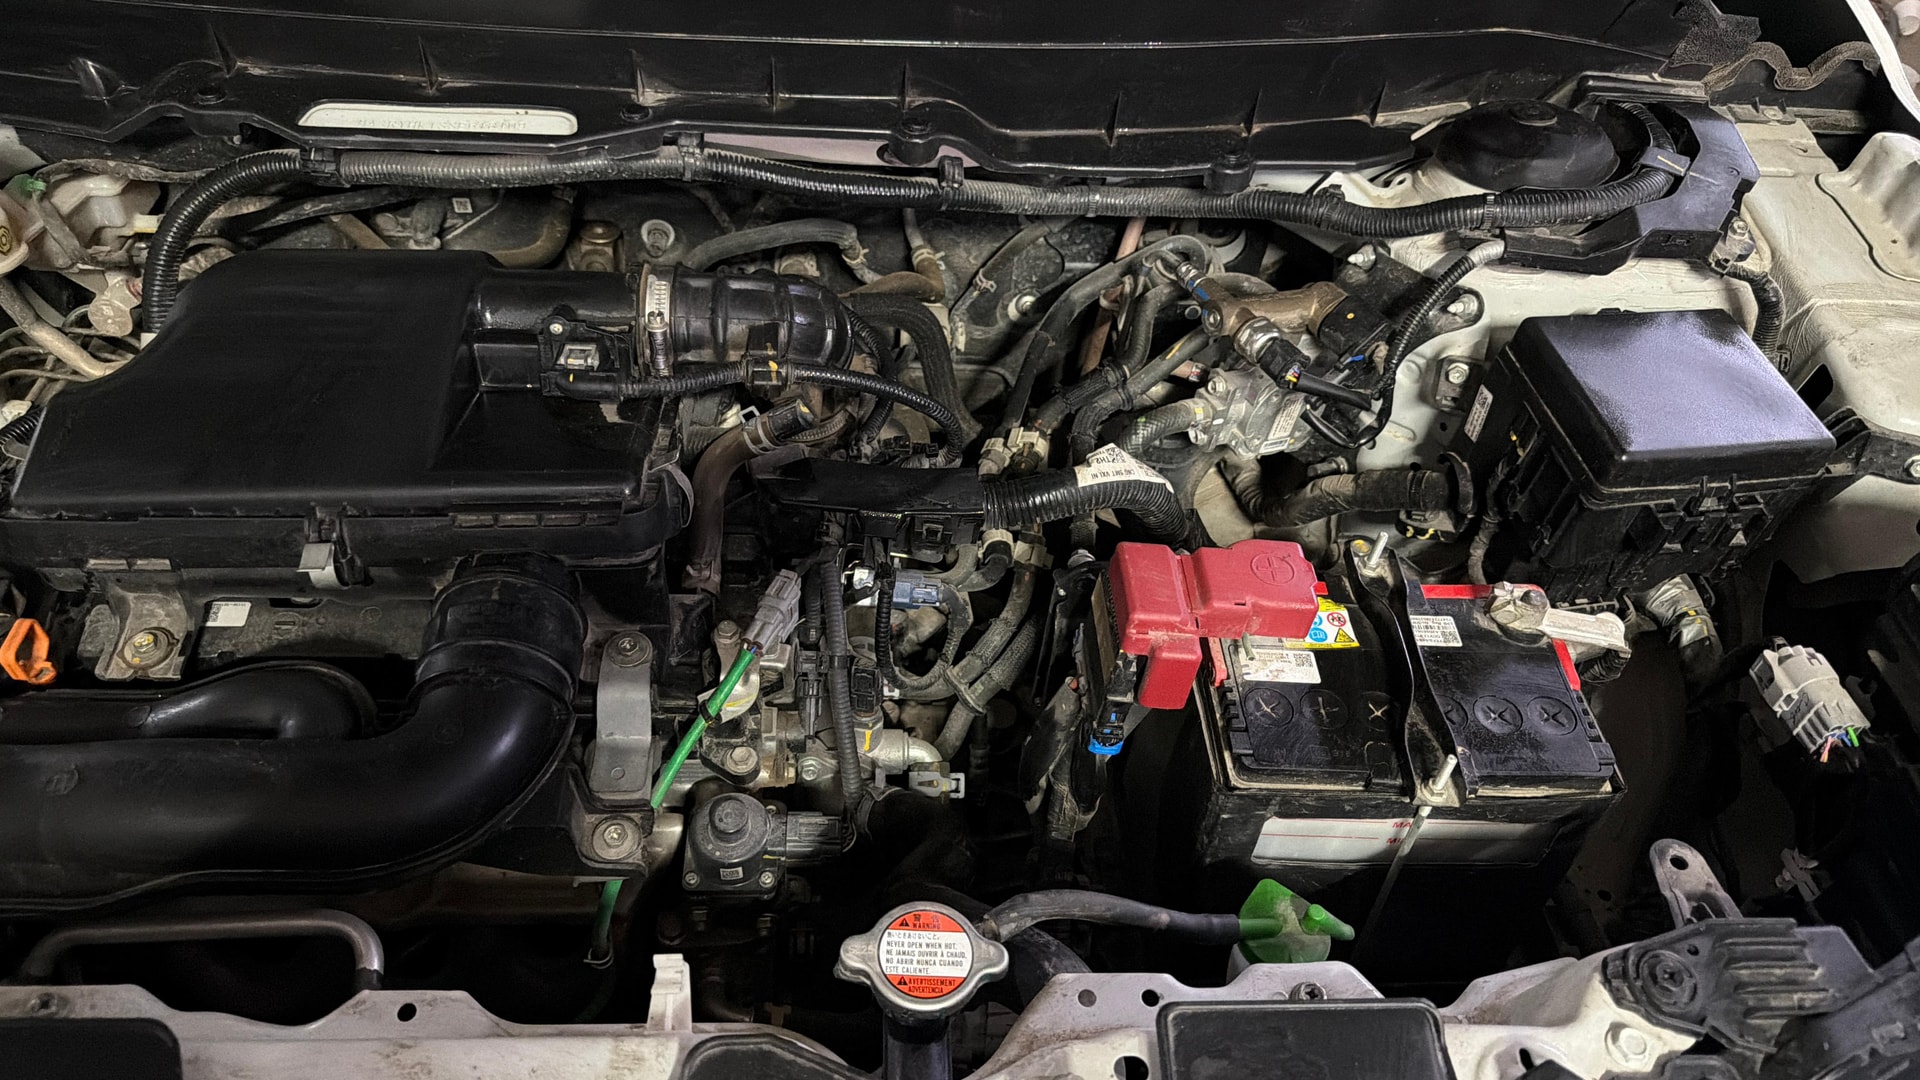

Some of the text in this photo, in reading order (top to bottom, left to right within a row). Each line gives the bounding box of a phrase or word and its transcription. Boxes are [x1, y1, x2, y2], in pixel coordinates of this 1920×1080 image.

[1392, 821, 1413, 829] MA
[912, 922, 941, 930] WARNING
[886, 940, 905, 948] NEVER
[907, 941, 923, 949] OPEN
[925, 942, 942, 950] WHEN
[895, 949, 916, 957] JAMAIS
[917, 950, 938, 958] OUVRIR
[885, 957, 964, 967] NO ABRIR NUNCA CUANDO
[885, 965, 899, 974] ESTE
[908, 978, 956, 987] AVERTISSEMENT
[908, 985, 944, 994] ADVERTENCIA
